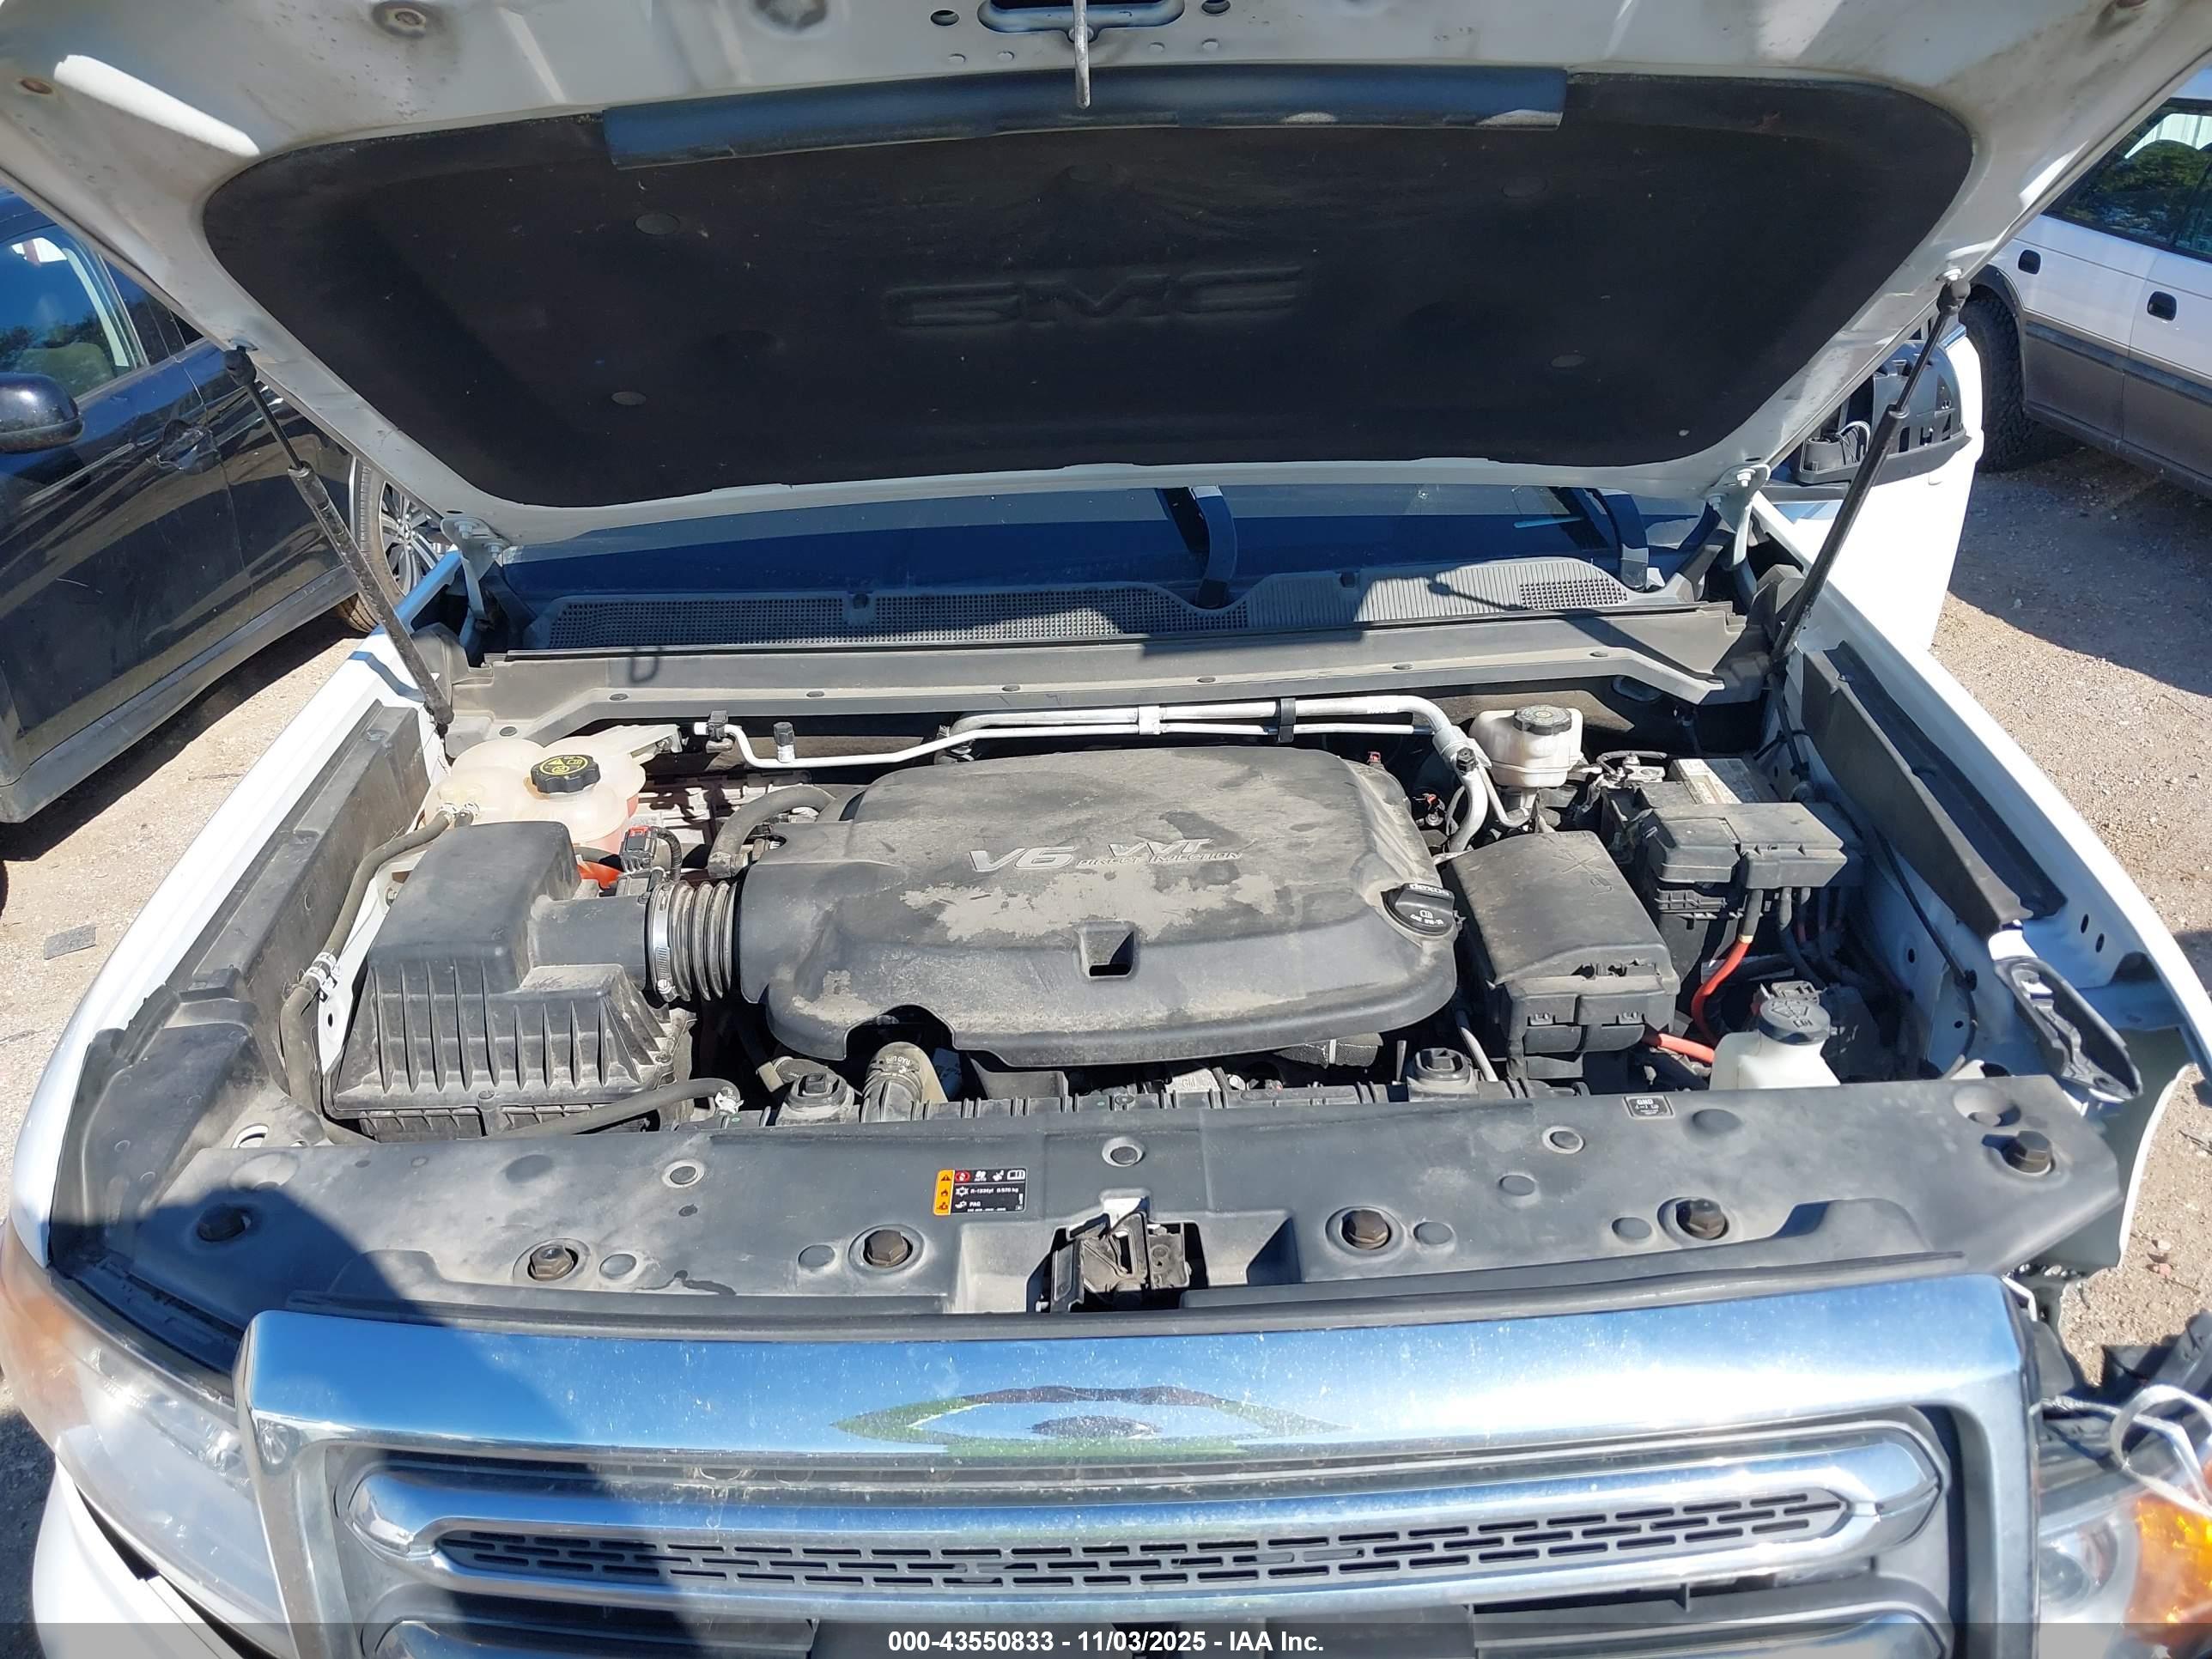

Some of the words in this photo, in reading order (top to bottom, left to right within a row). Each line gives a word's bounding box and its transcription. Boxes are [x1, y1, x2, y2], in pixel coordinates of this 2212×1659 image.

[883, 264, 1305, 330] GMC
[969, 846, 1077, 872] V6
[1075, 855, 1142, 868] DIRECT
[1147, 851, 1243, 864] INJECTION
[1108, 838, 1214, 858] VVT
